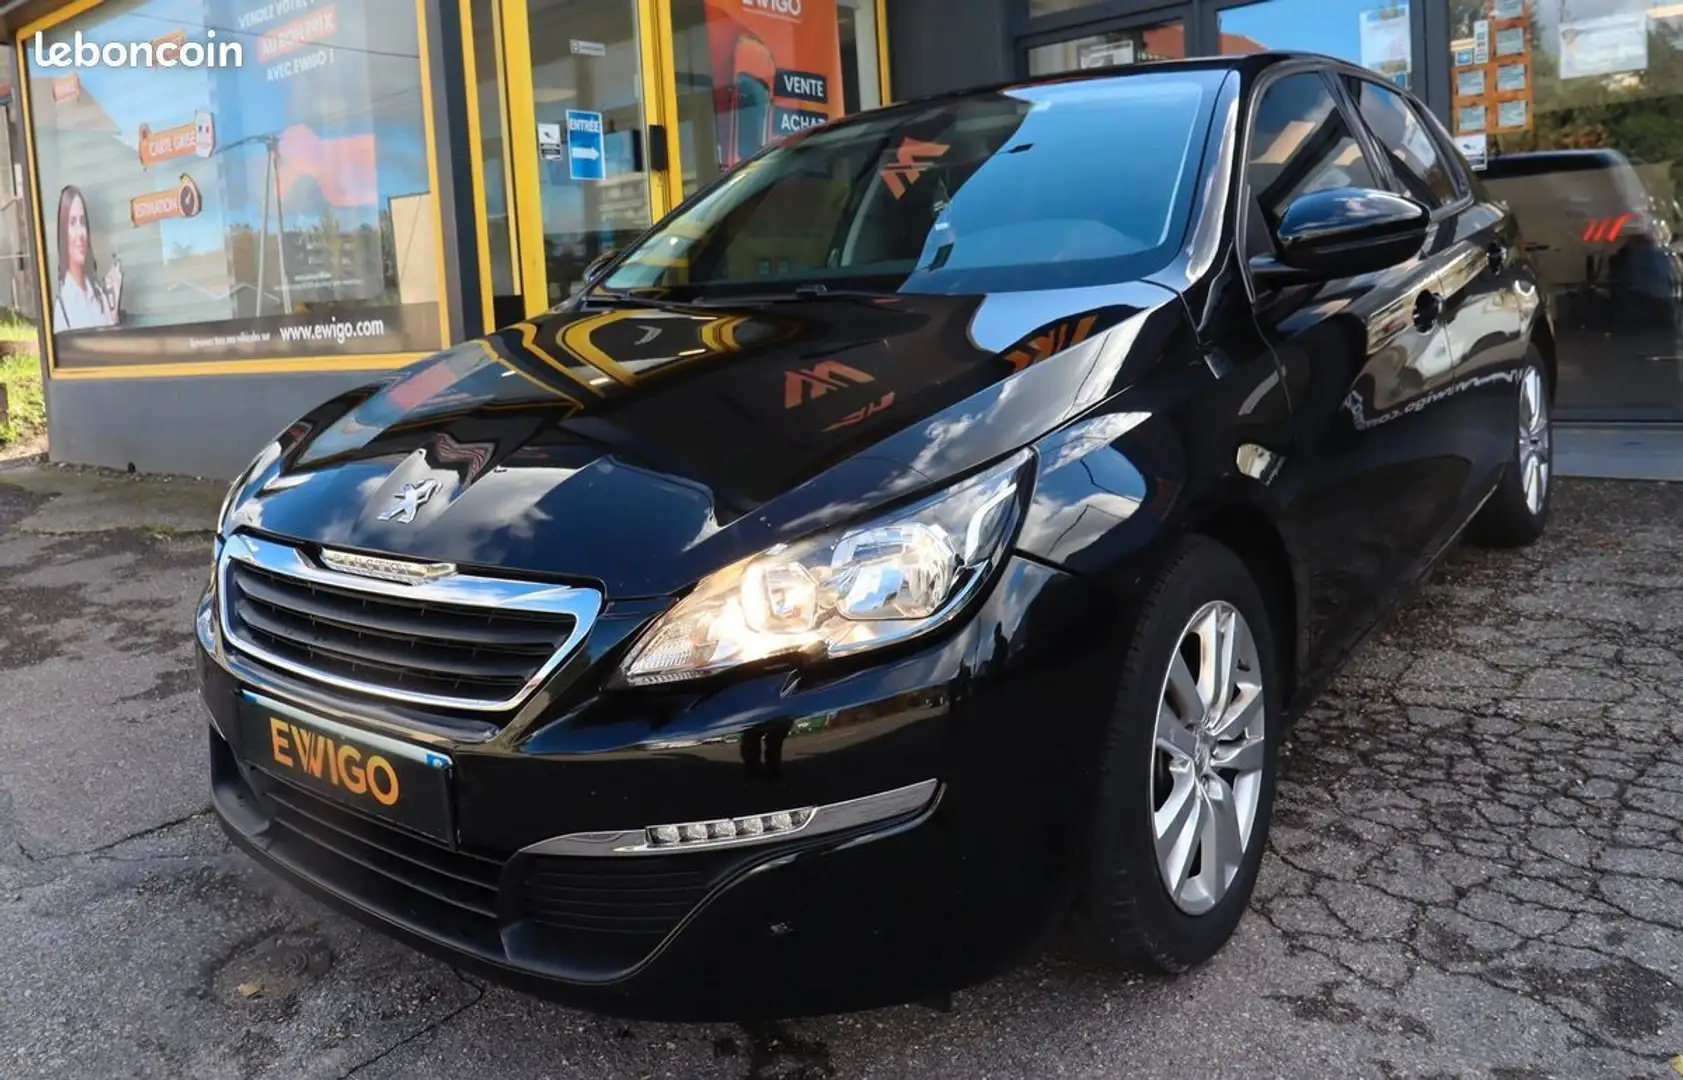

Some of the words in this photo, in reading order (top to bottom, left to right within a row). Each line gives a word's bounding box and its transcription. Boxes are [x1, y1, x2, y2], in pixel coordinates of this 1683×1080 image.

[267, 61, 292, 82] AVEC
[783, 75, 825, 97] VENTE
[569, 117, 601, 132] ENTRÉE
[279, 316, 385, 344] www.ewigo.com
[269, 716, 400, 806] EWIGO
